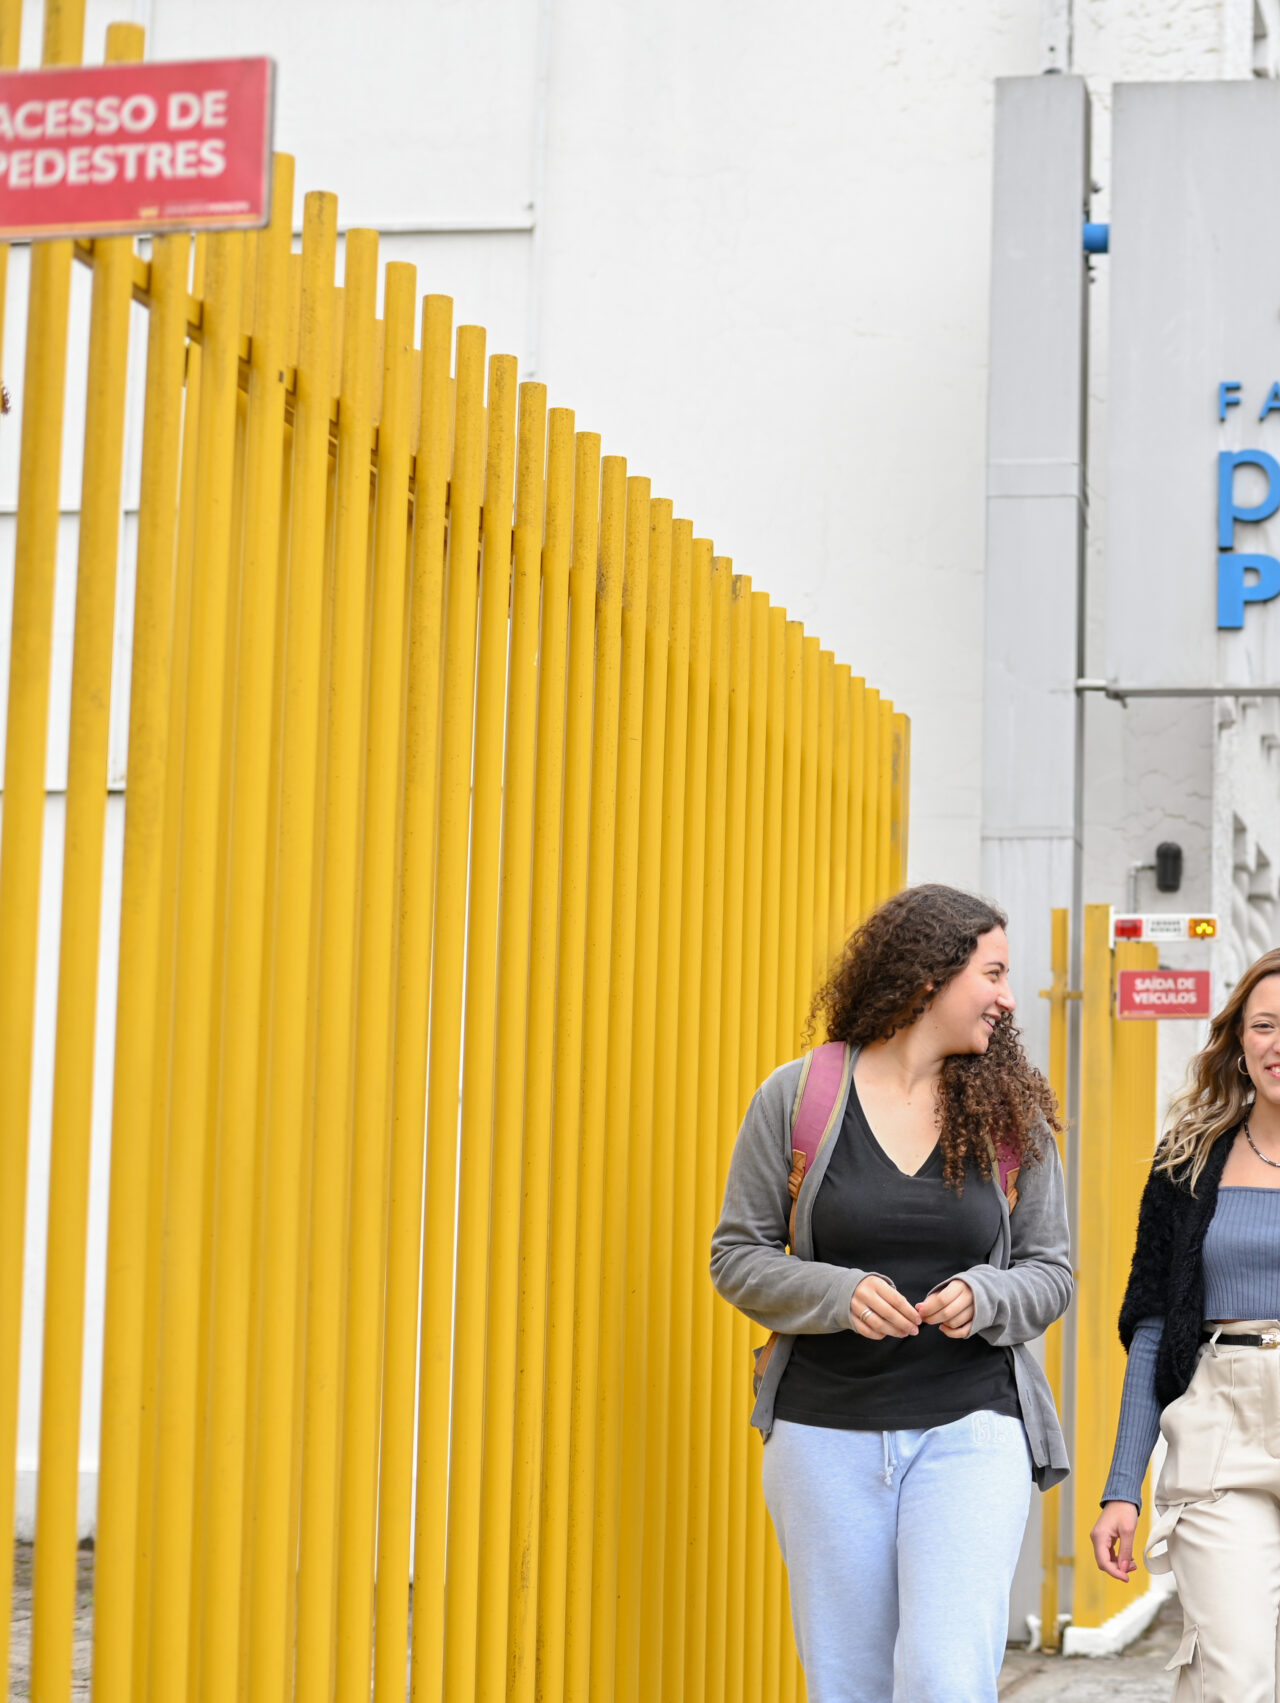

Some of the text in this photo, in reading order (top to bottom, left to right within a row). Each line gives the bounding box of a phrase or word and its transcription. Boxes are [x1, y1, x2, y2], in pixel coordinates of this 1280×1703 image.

[168, 90, 228, 131] DE
[1134, 976, 1196, 991] SAÍDA DE
